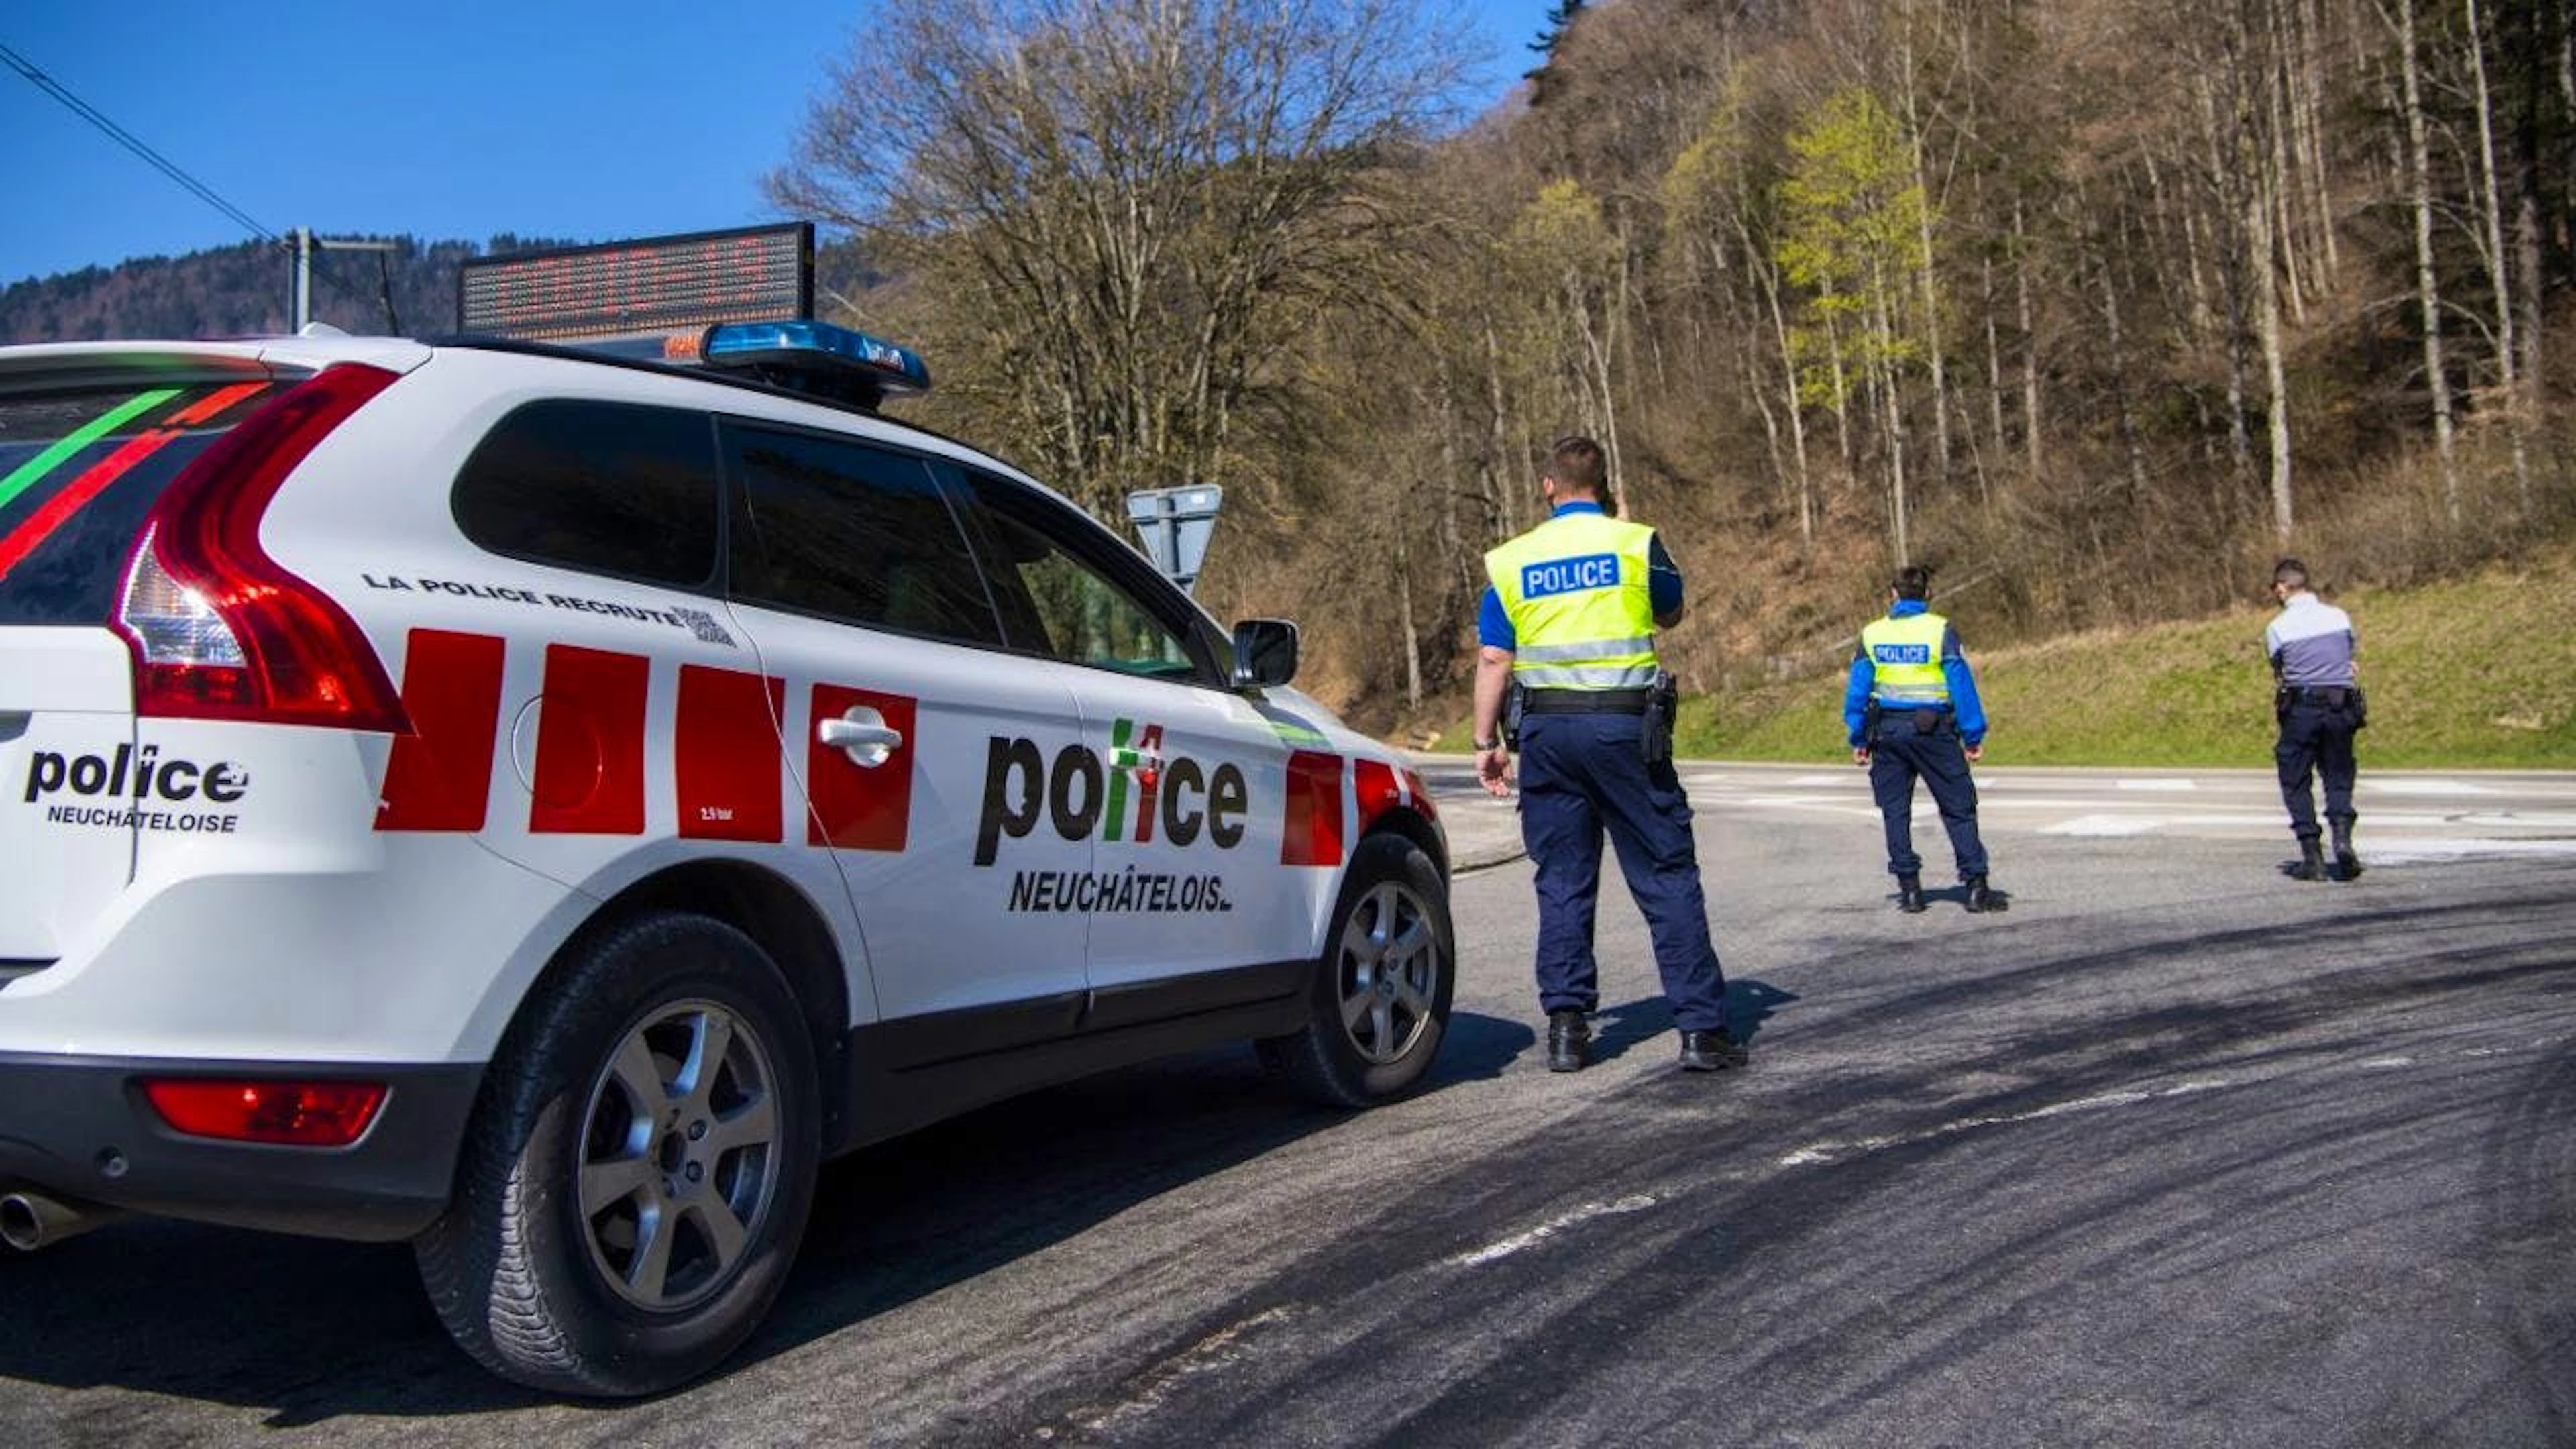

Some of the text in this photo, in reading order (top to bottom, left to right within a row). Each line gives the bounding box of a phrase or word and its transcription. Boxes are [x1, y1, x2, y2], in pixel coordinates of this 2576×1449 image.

[1528, 558, 1613, 595] POLICE
[362, 574, 685, 627] LA POLICE RECRUTE
[1876, 647, 1926, 661] POLICE
[24, 743, 248, 803] police
[973, 718, 1248, 866] police
[48, 806, 238, 833] NEUCHÂTELOISE
